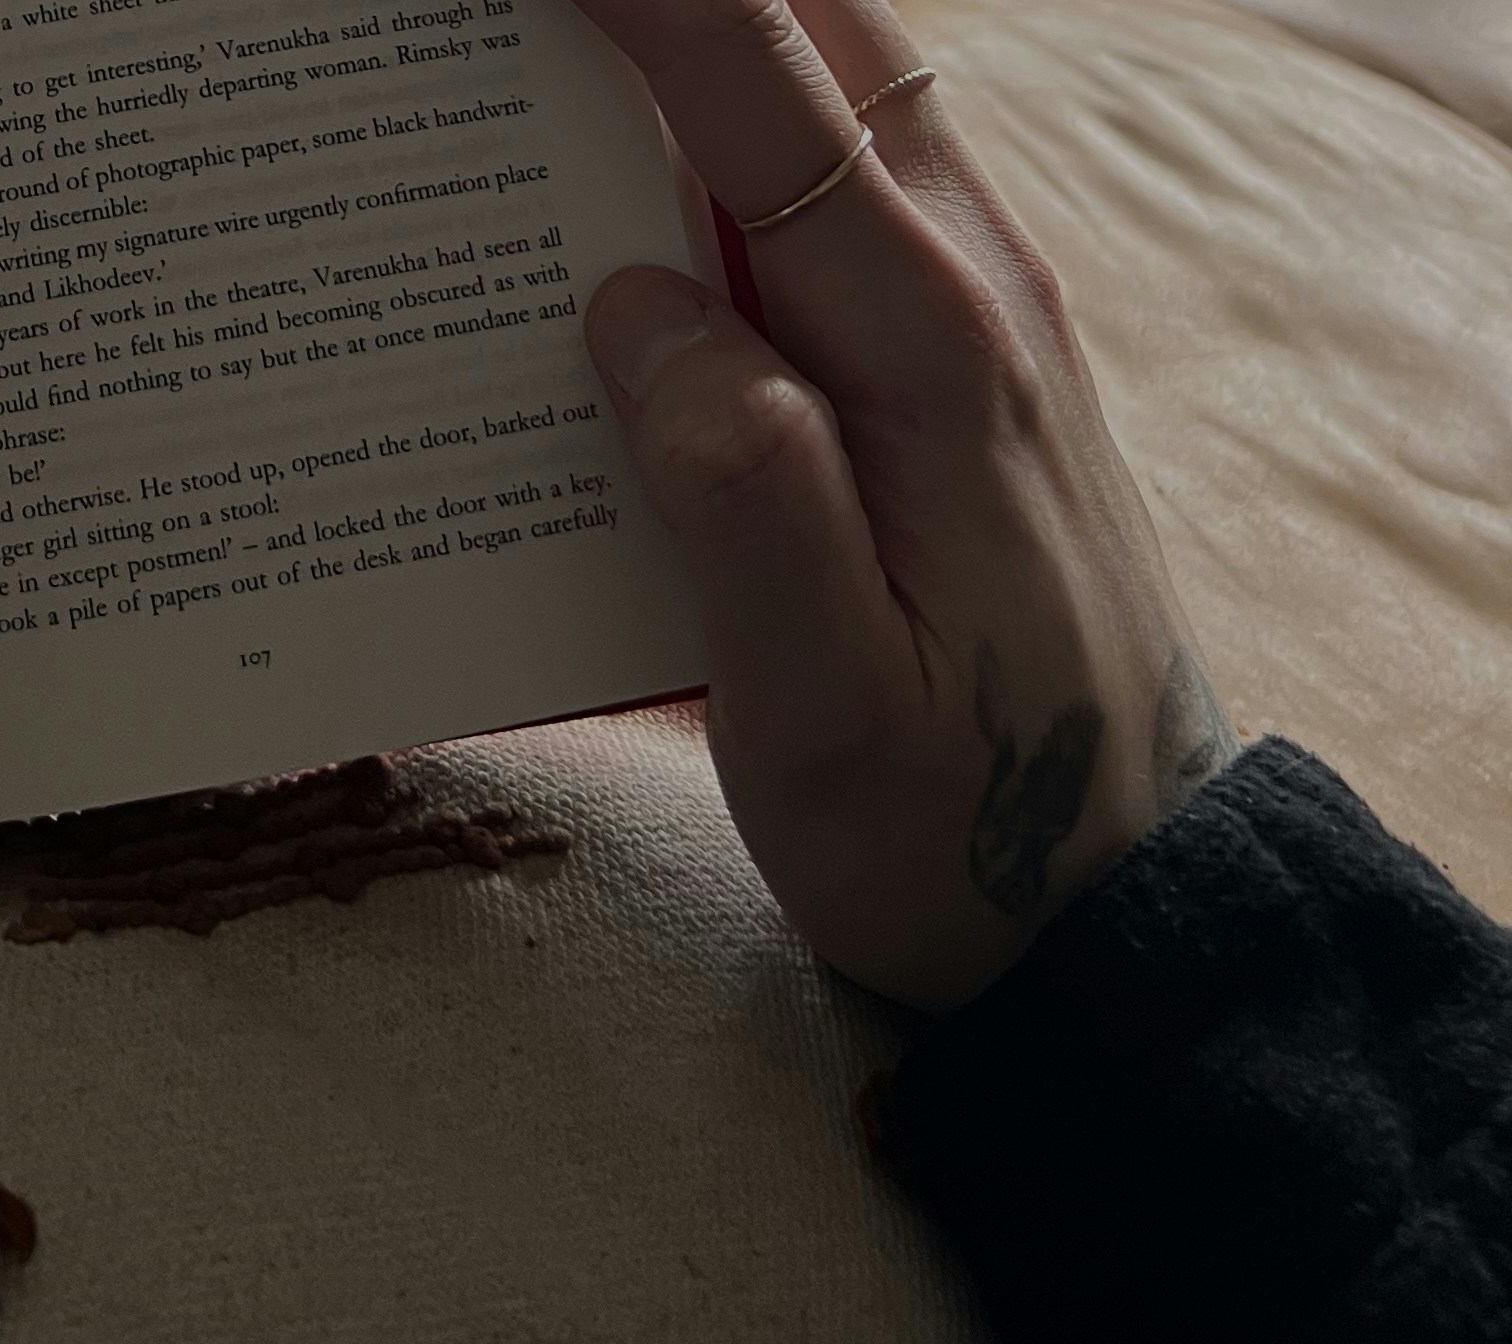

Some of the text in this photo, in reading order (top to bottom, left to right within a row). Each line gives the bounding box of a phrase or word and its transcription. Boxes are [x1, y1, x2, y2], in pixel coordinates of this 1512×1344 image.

[0, 16, 13, 31] a
[20, 1, 79, 27] white
[65, 165, 90, 191] of
[94, 143, 236, 193] photographic
[239, 137, 307, 168] paper,
[311, 126, 368, 149] some
[371, 110, 430, 138] black
[431, 93, 534, 128] handwrit-
[47, 378, 91, 407] find
[97, 367, 183, 399] nothing
[189, 364, 212, 382] to
[219, 356, 253, 380] say
[259, 347, 298, 369] but
[304, 338, 339, 362] the
[345, 335, 368, 355] at
[373, 326, 426, 349] once
[432, 306, 531, 339] mundane
[536, 292, 577, 320] and
[46, 610, 60, 626] a
[67, 596, 109, 630] pile
[116, 587, 141, 614] of
[148, 582, 222, 617] papers
[230, 572, 268, 594] out
[276, 559, 301, 586] of
[309, 556, 344, 580] the
[352, 542, 403, 572] desk
[409, 532, 451, 562] and
[456, 526, 523, 554] began
[529, 502, 618, 538] carefully
[238, 648, 271, 669] 107
